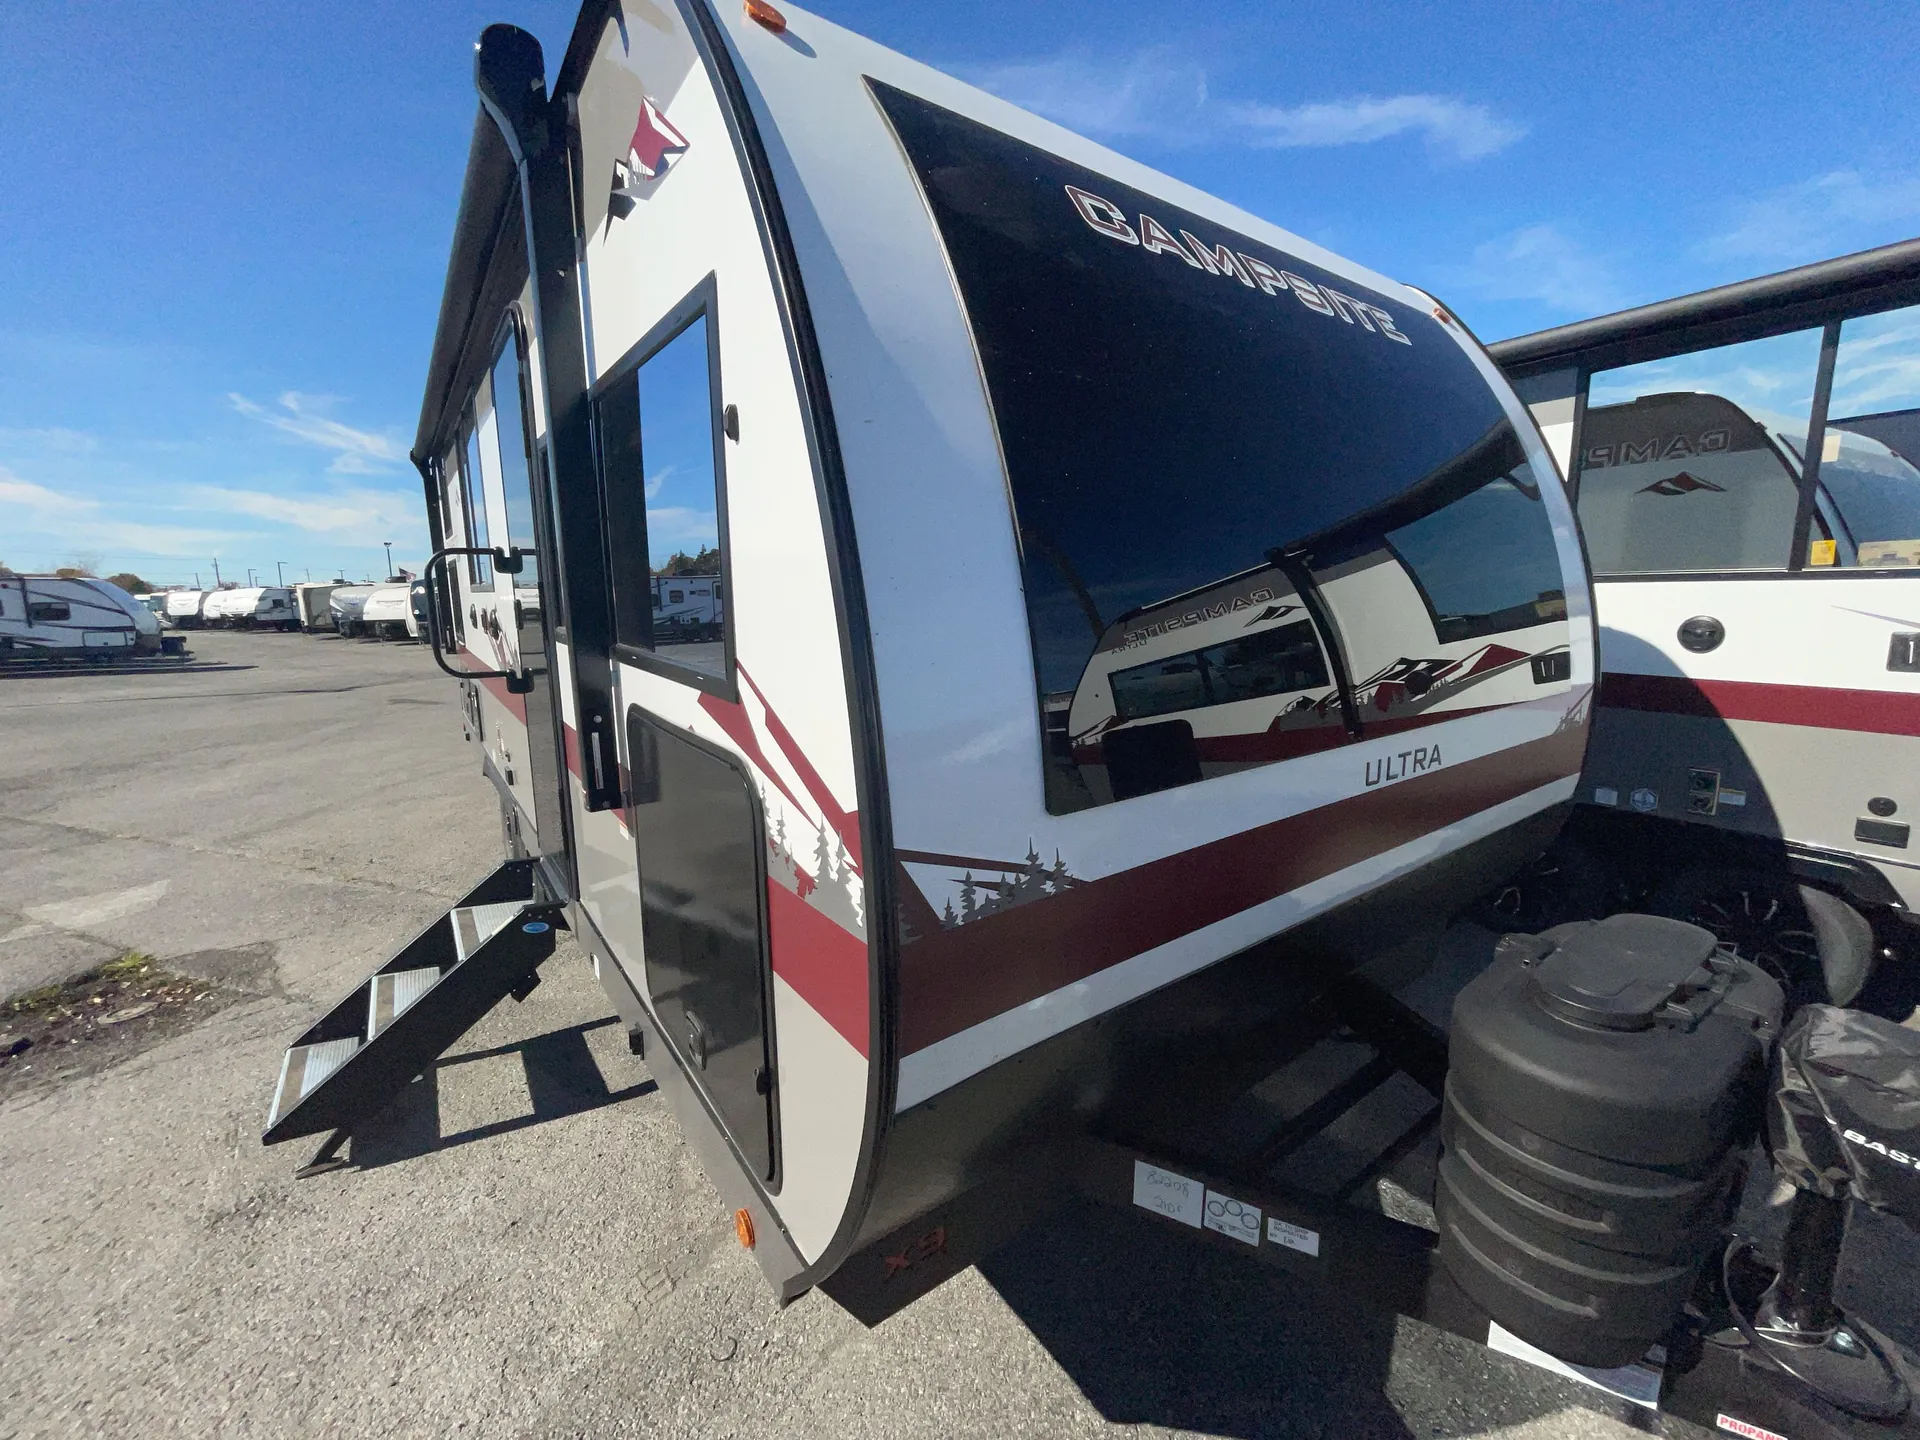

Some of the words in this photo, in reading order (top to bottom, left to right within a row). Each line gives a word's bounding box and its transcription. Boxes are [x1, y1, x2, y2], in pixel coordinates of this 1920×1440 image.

[1065, 185, 1412, 345] CAMPSITE
[1365, 744, 1442, 786] ULTRA
[1720, 1416, 1784, 1440] PROPAN
